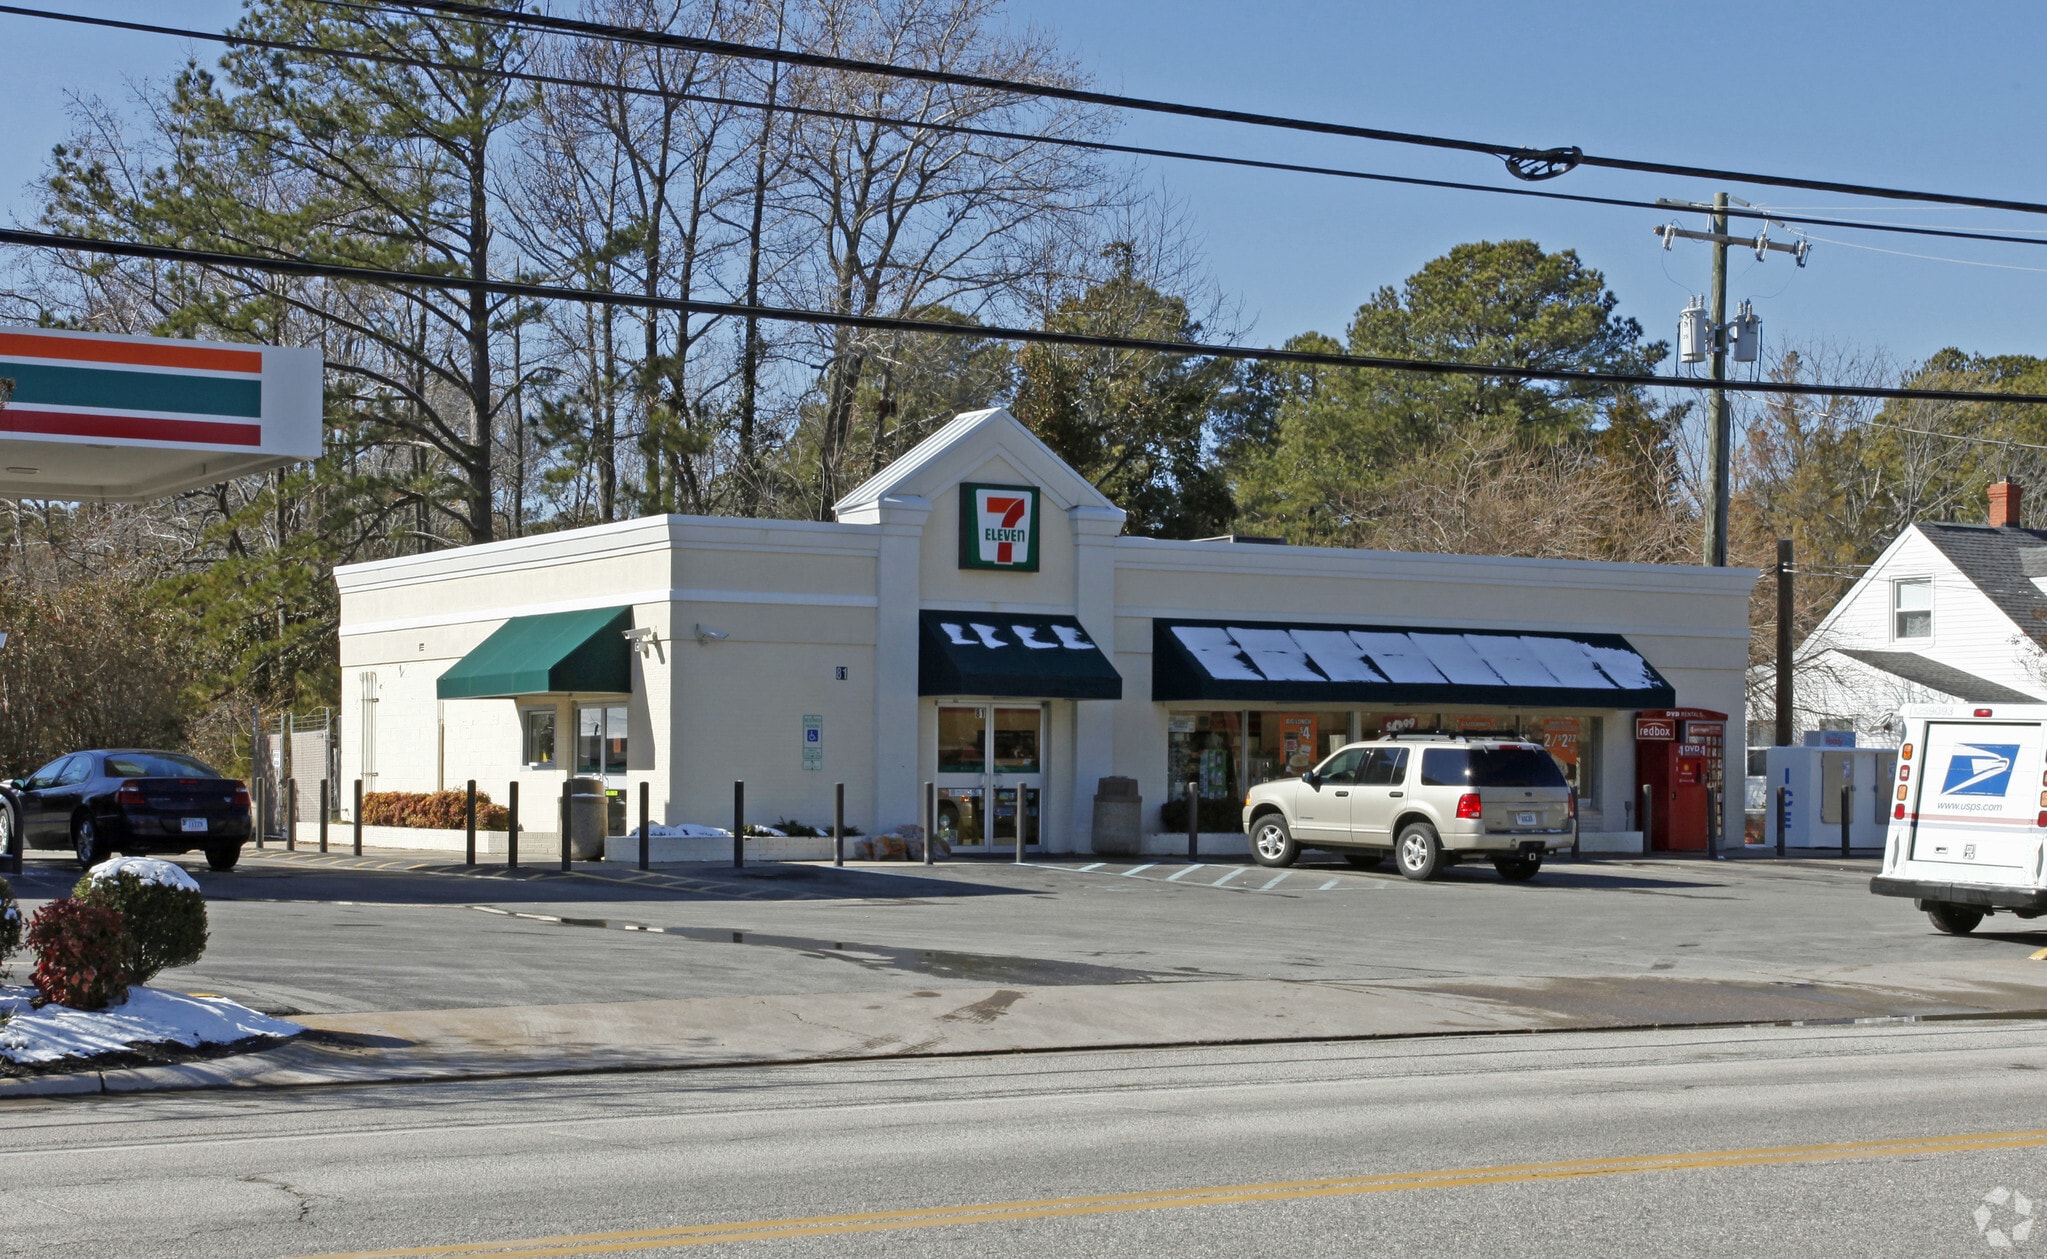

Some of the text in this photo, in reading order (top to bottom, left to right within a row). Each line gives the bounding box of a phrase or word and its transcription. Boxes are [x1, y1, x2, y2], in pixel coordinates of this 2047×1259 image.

[987, 497, 1024, 563] 7
[836, 667, 848, 680] 81
[975, 708, 985, 718] 81
[1913, 705, 1954, 716] 1259093
[1299, 726, 1311, 740] $4
[1639, 724, 1671, 737] redbox
[1937, 801, 2003, 813] www.usps.com
